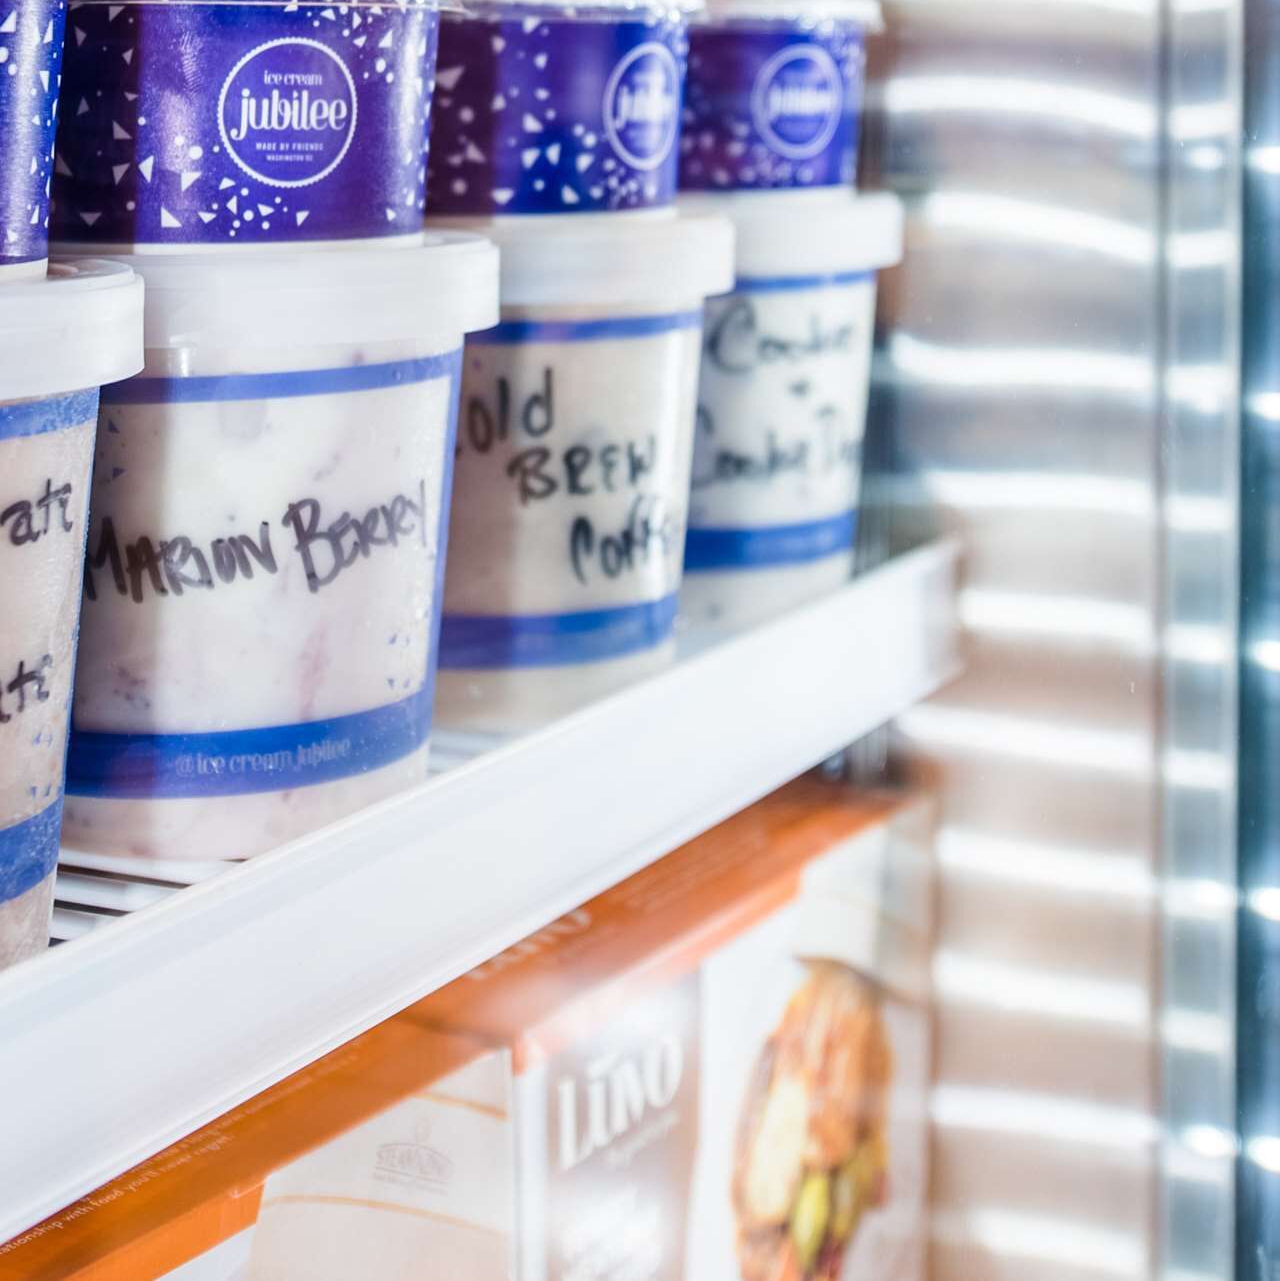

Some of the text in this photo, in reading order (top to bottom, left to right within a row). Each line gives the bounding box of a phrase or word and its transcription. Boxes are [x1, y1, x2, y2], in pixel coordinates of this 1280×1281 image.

[263, 69, 323, 86] ice cream
[230, 88, 348, 141] jubilee
[255, 142, 324, 151] MADE BY FRIENDS
[455, 364, 554, 456] old
